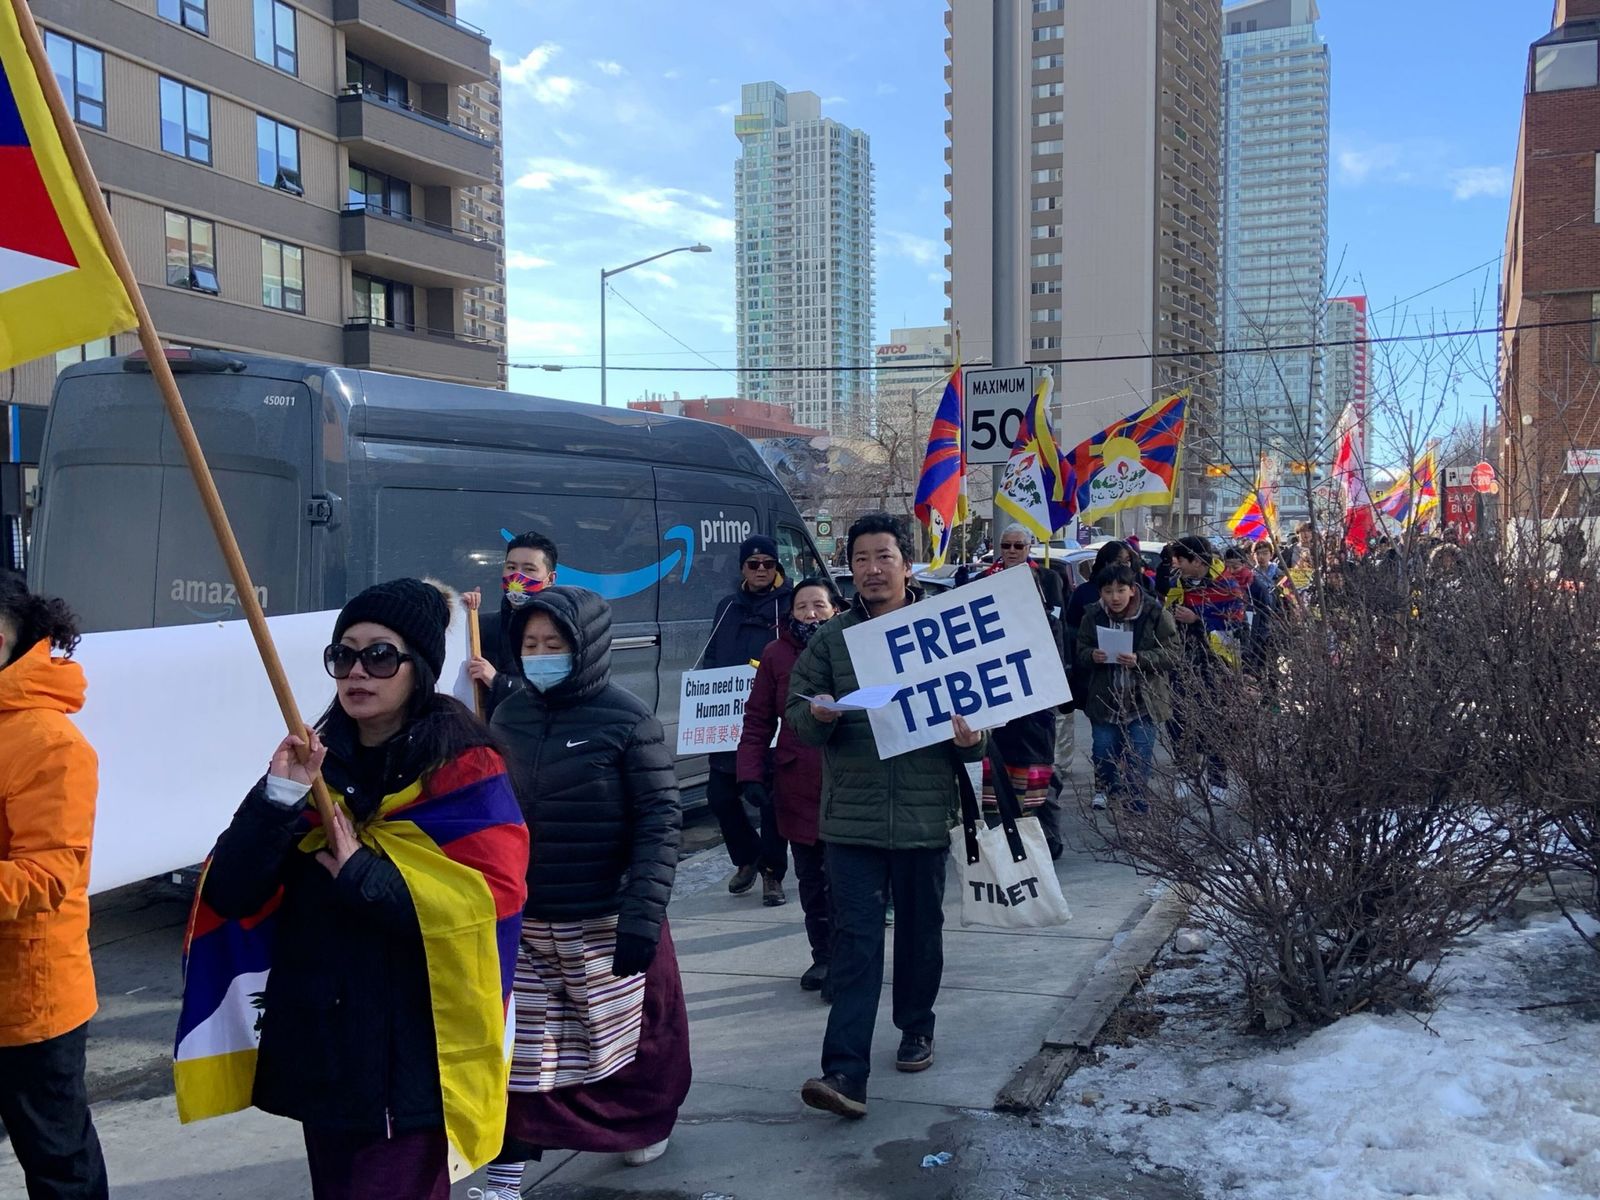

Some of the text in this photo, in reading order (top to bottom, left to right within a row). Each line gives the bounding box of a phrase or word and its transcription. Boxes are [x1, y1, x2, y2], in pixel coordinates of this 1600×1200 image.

[877, 344, 907, 355] ATCO
[263, 396, 296, 406] 450011
[973, 378, 1025, 395] MAXIMUM
[970, 408, 1025, 450] 50
[700, 511, 751, 552] prime
[170, 579, 268, 609] amazn
[885, 594, 1006, 675] FREE
[685, 679, 710, 697] China
[712, 676, 733, 694] need
[735, 676, 744, 692] to
[890, 648, 1034, 733] TIBET
[696, 702, 730, 719] Human
[968, 877, 1039, 907] TIBET
